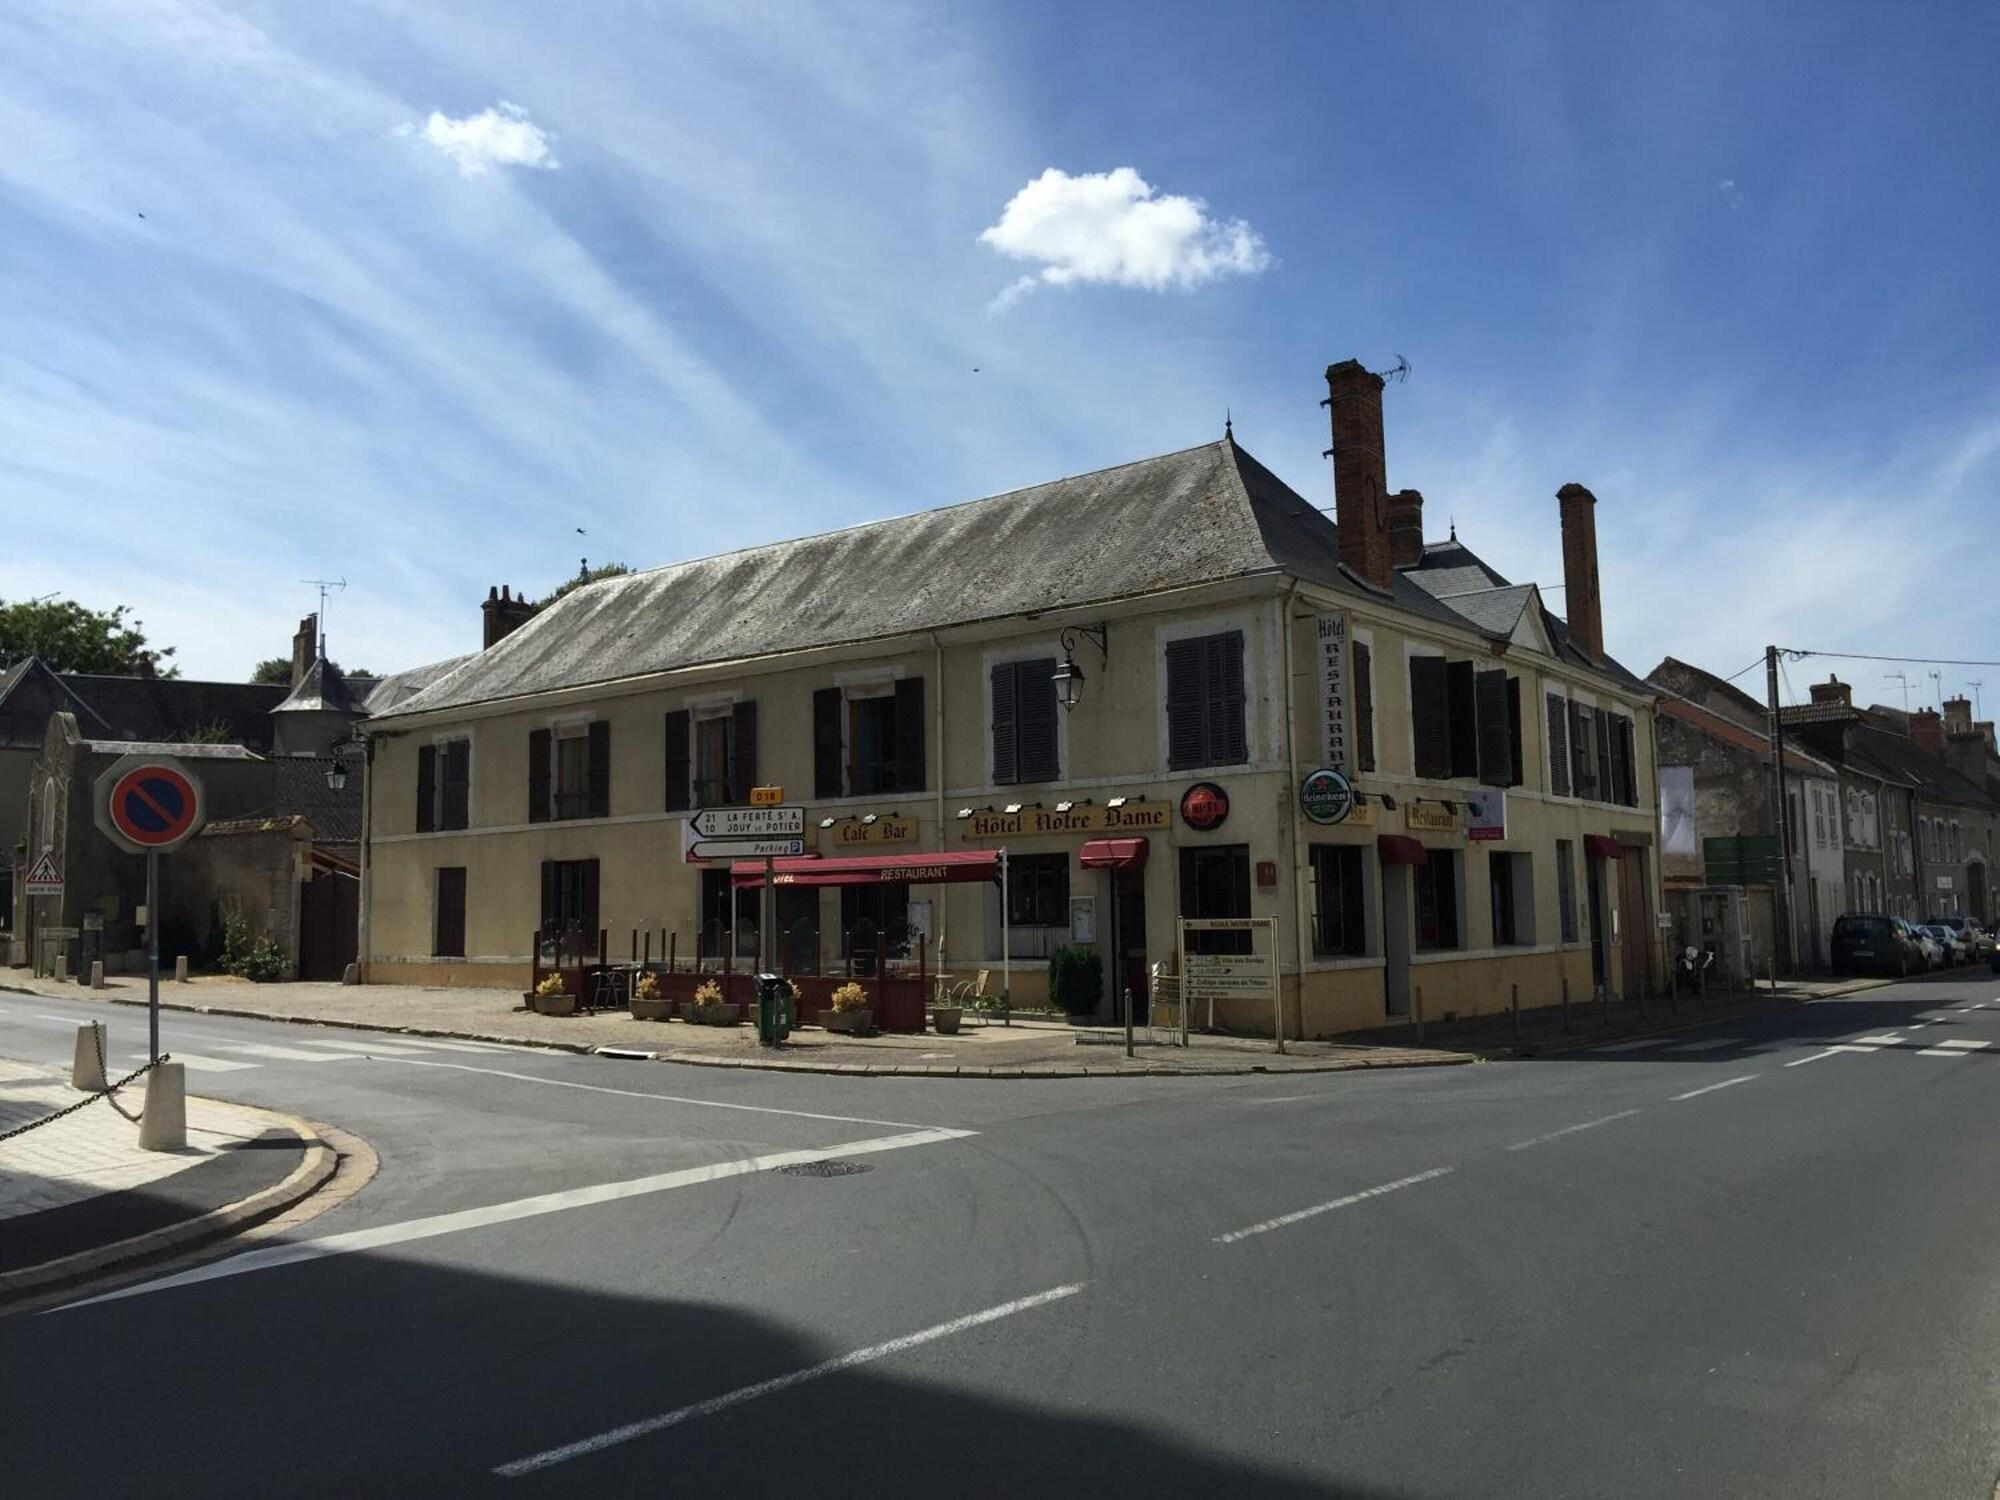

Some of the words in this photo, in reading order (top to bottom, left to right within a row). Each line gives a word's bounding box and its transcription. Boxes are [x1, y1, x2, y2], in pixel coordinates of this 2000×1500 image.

[1303, 791, 1347, 802] Heineken
[706, 814, 716, 822] 21
[727, 814, 738, 822] LA
[743, 811, 772, 821] FERTÉ
[973, 815, 1021, 834] Hôtel
[1036, 812, 1090, 831] Notre
[1105, 807, 1163, 826] Dame
[705, 824, 715, 832] 10
[727, 823, 751, 832] JOUY
[766, 822, 801, 832] POTIER
[883, 822, 907, 839] Bar
[754, 843, 789, 854] Parking
[880, 866, 948, 880] RESTAURANT
[773, 874, 794, 884] OTEL
